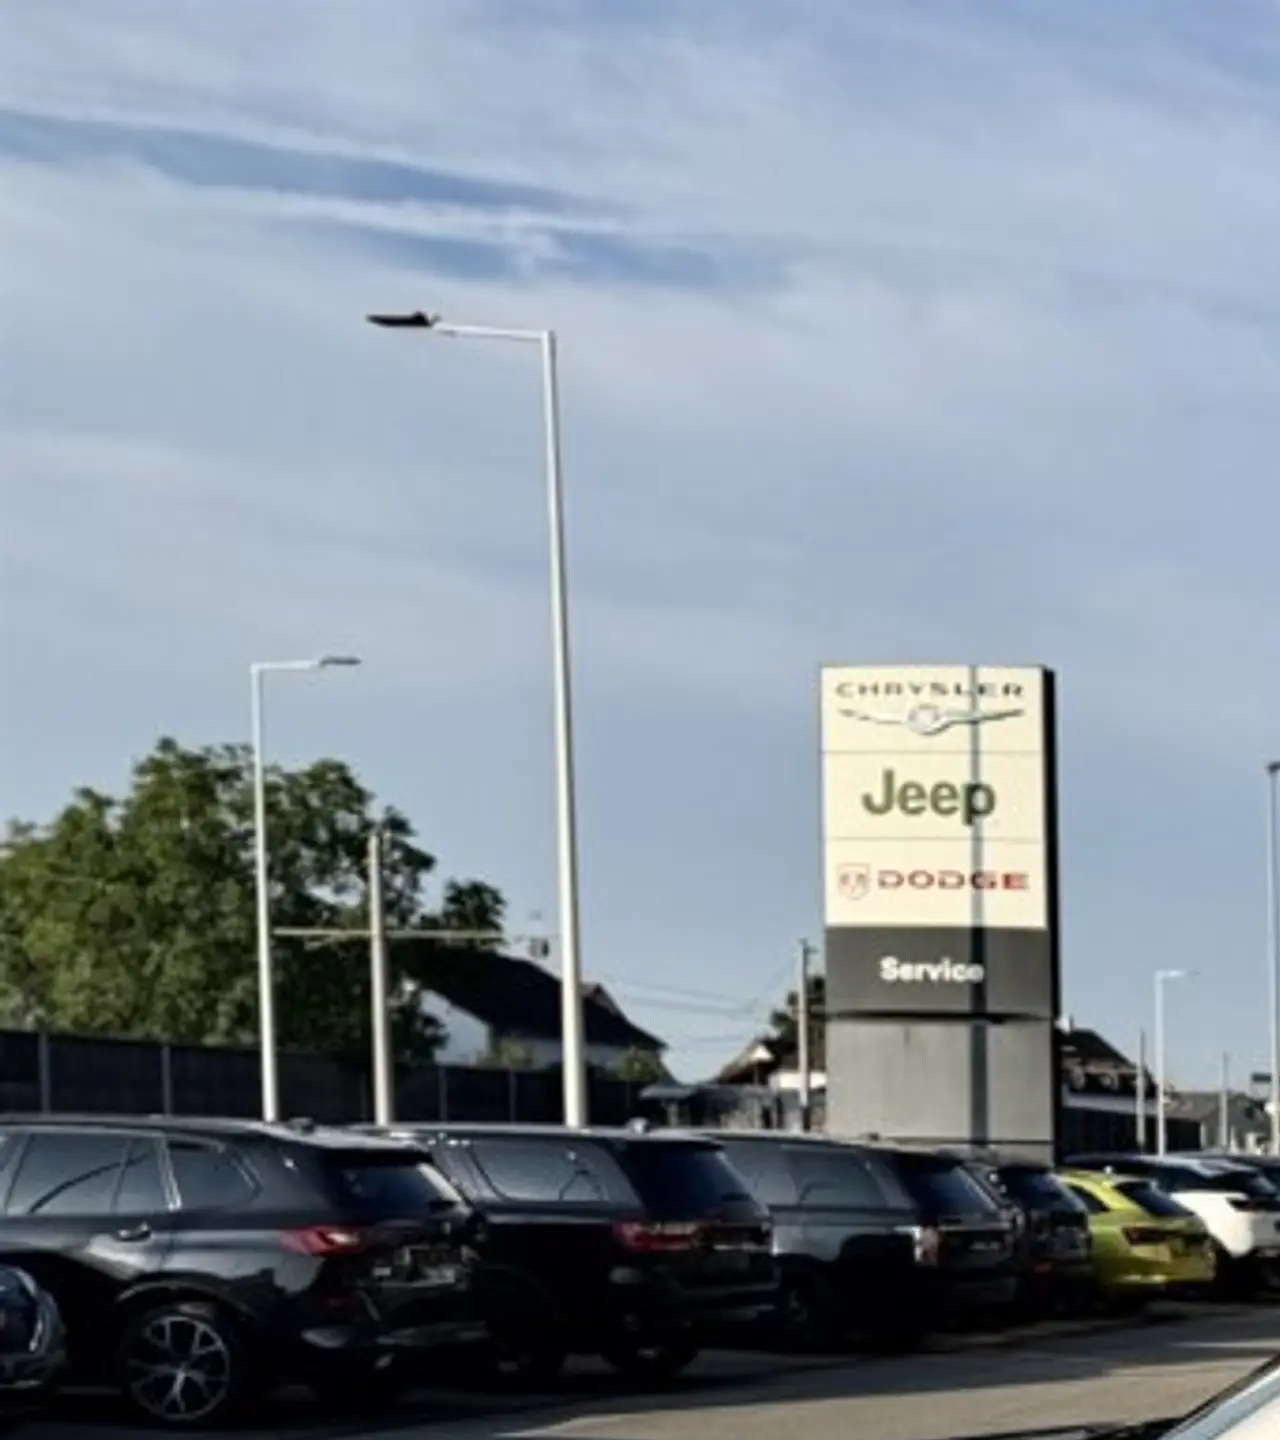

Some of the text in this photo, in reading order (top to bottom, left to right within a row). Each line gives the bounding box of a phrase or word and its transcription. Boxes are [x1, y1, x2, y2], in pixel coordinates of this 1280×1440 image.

[835, 682, 1024, 697] CHRYSLER
[861, 768, 996, 826] Jeep
[877, 870, 1029, 890] DODGE
[880, 956, 985, 983] Service
